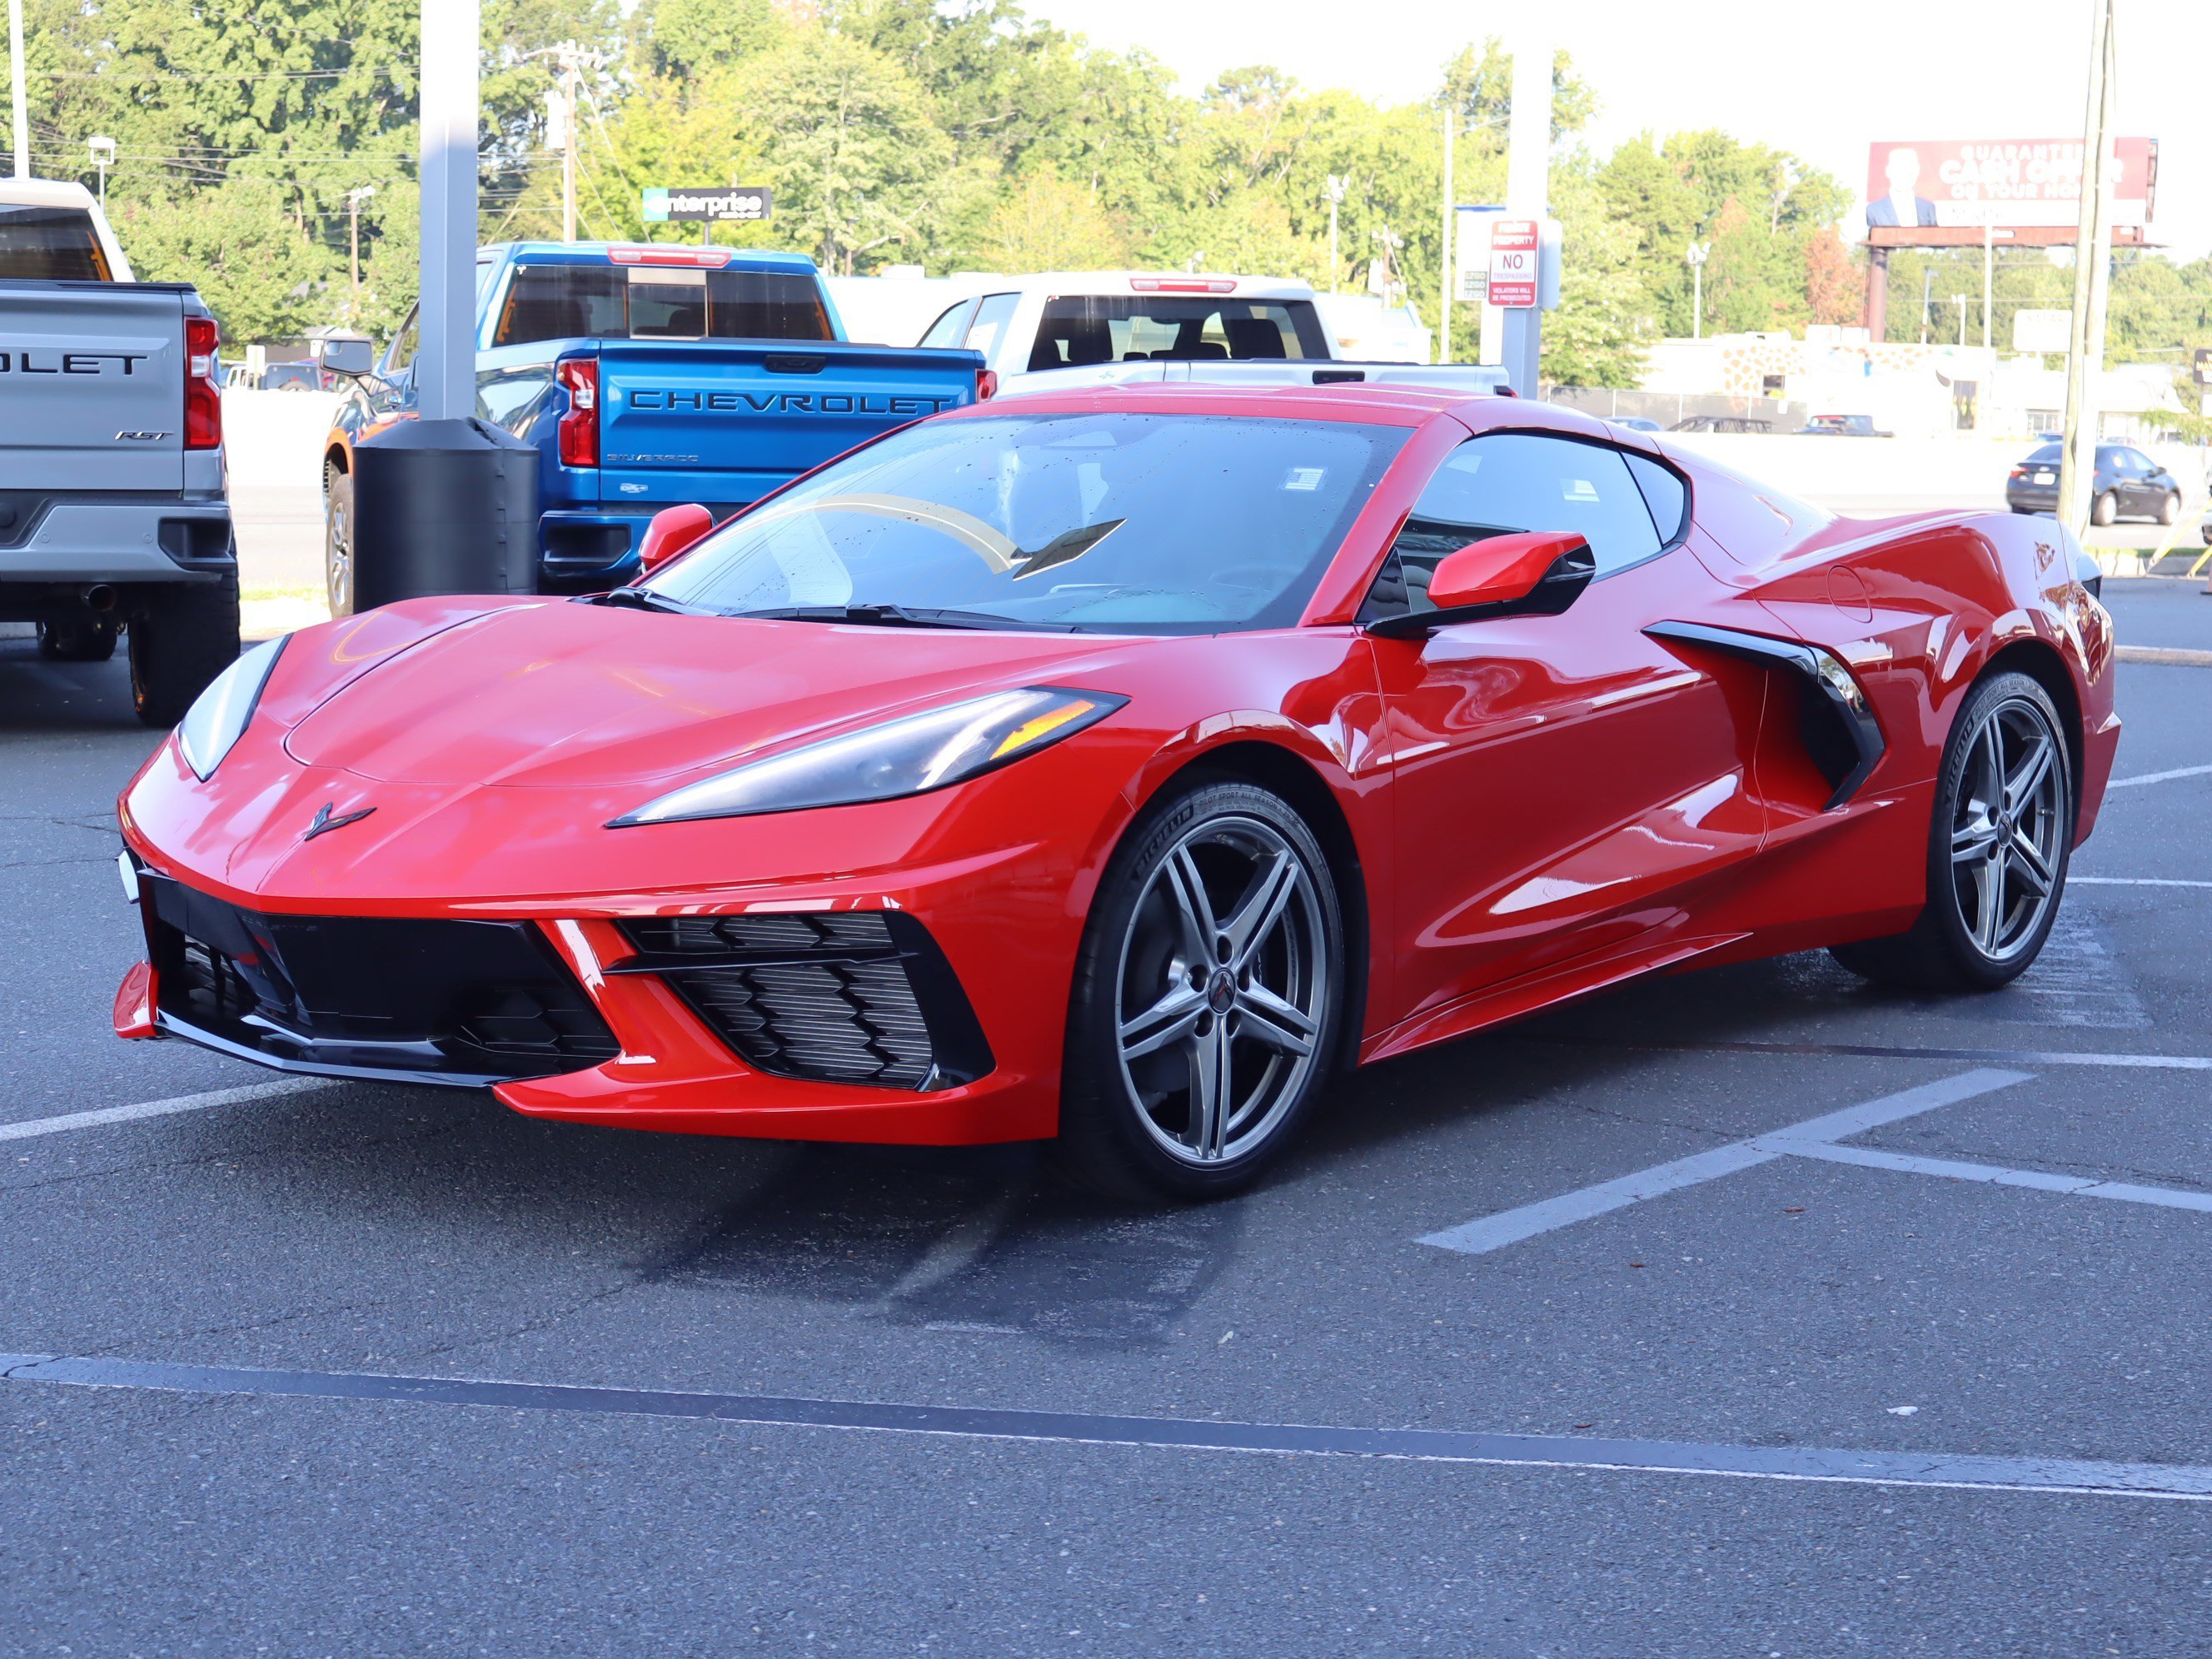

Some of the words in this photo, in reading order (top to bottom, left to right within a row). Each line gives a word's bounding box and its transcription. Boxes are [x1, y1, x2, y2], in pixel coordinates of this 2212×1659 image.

[1960, 144, 2084, 161] GUARANTEE
[1939, 159, 2020, 184] CASH
[2025, 159, 2125, 184] OFFR
[1985, 183, 2040, 200] YOUR
[1502, 254, 1523, 269] NO
[1493, 272, 1532, 281] TRESPASSING
[0, 353, 148, 375] LET
[630, 391, 953, 415] CHEVROLET
[114, 431, 174, 441] RST
[607, 454, 699, 462] SILVERADO
[1218, 792, 1239, 800] SPORT
[1241, 792, 1253, 800] ALL
[1253, 795, 1278, 810] SEASON
